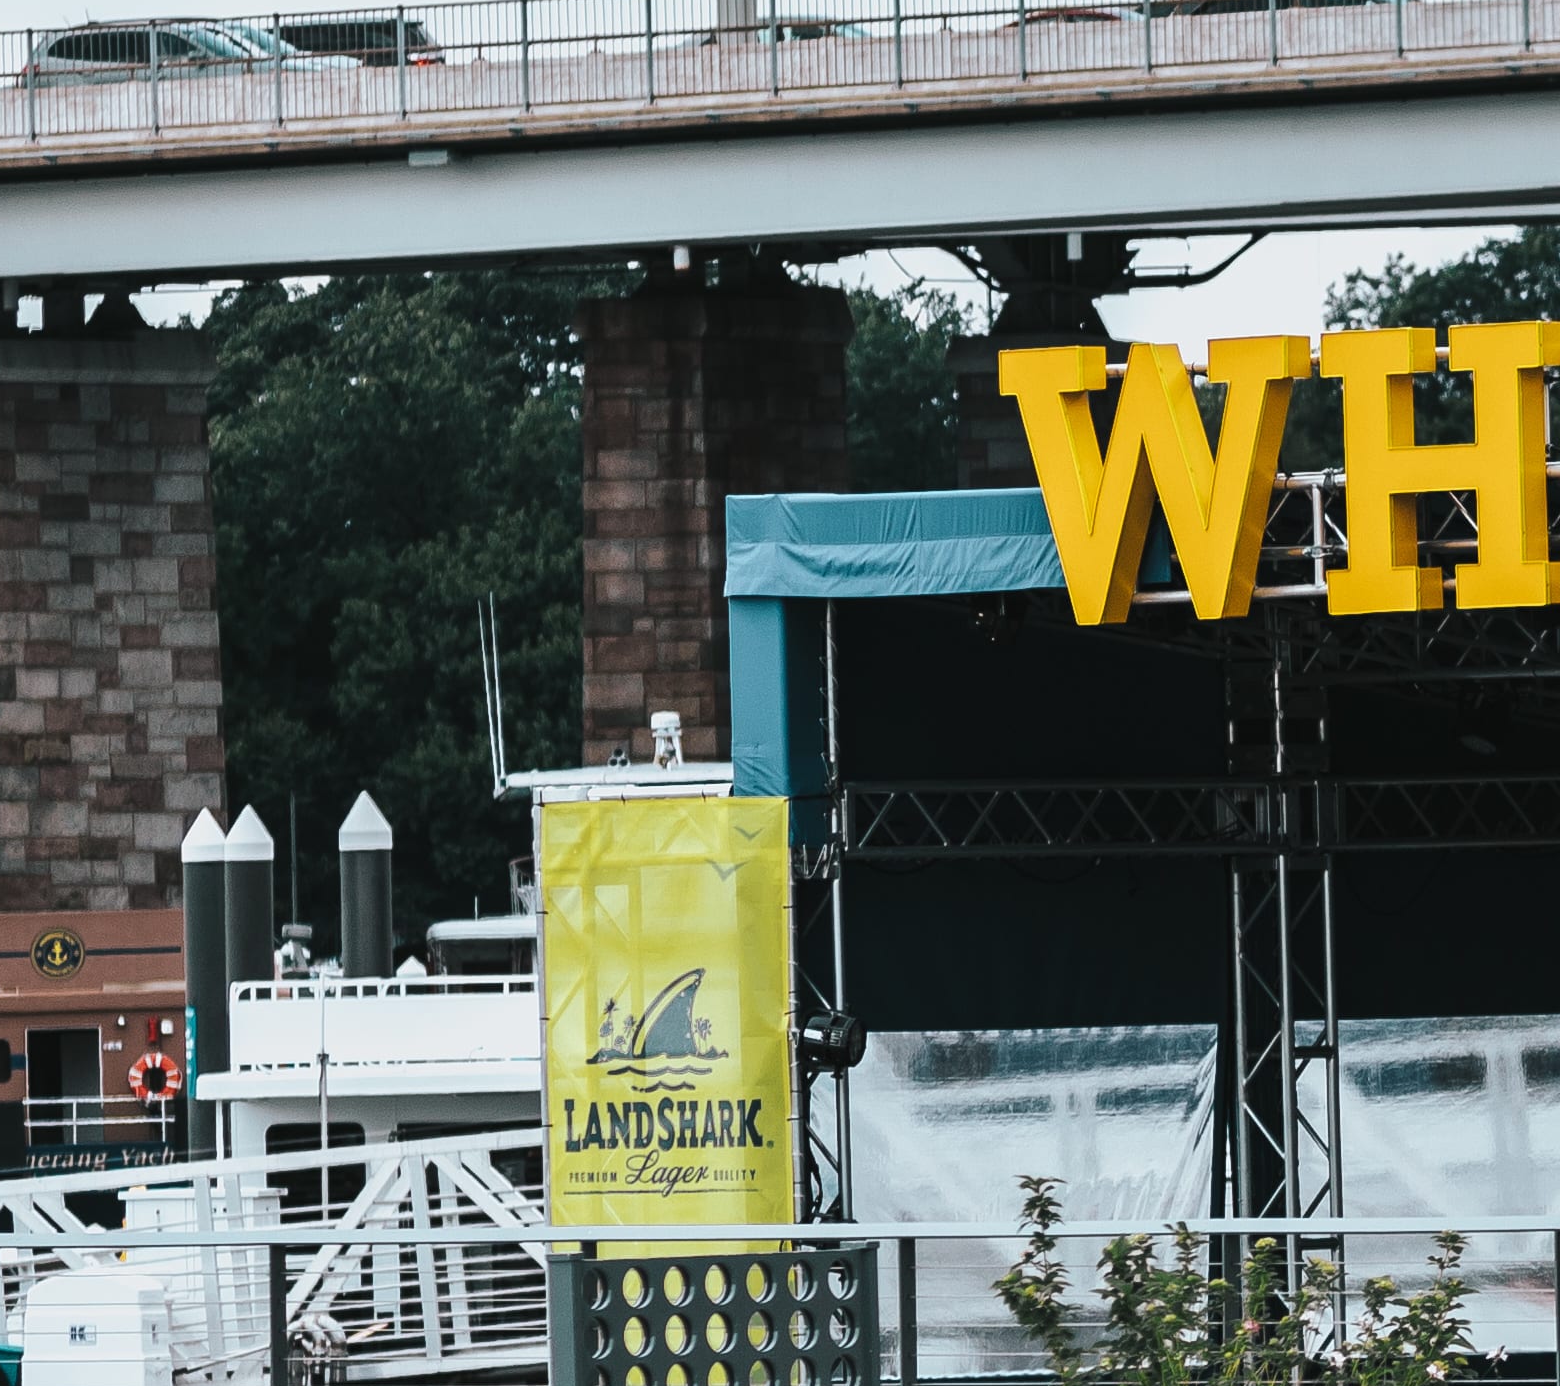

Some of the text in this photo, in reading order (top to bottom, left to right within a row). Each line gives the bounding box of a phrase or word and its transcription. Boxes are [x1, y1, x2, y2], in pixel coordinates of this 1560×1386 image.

[564, 1097, 763, 1152] LANDSHARK
[569, 1149, 757, 1197] PREMIUM Lager QUALITY
